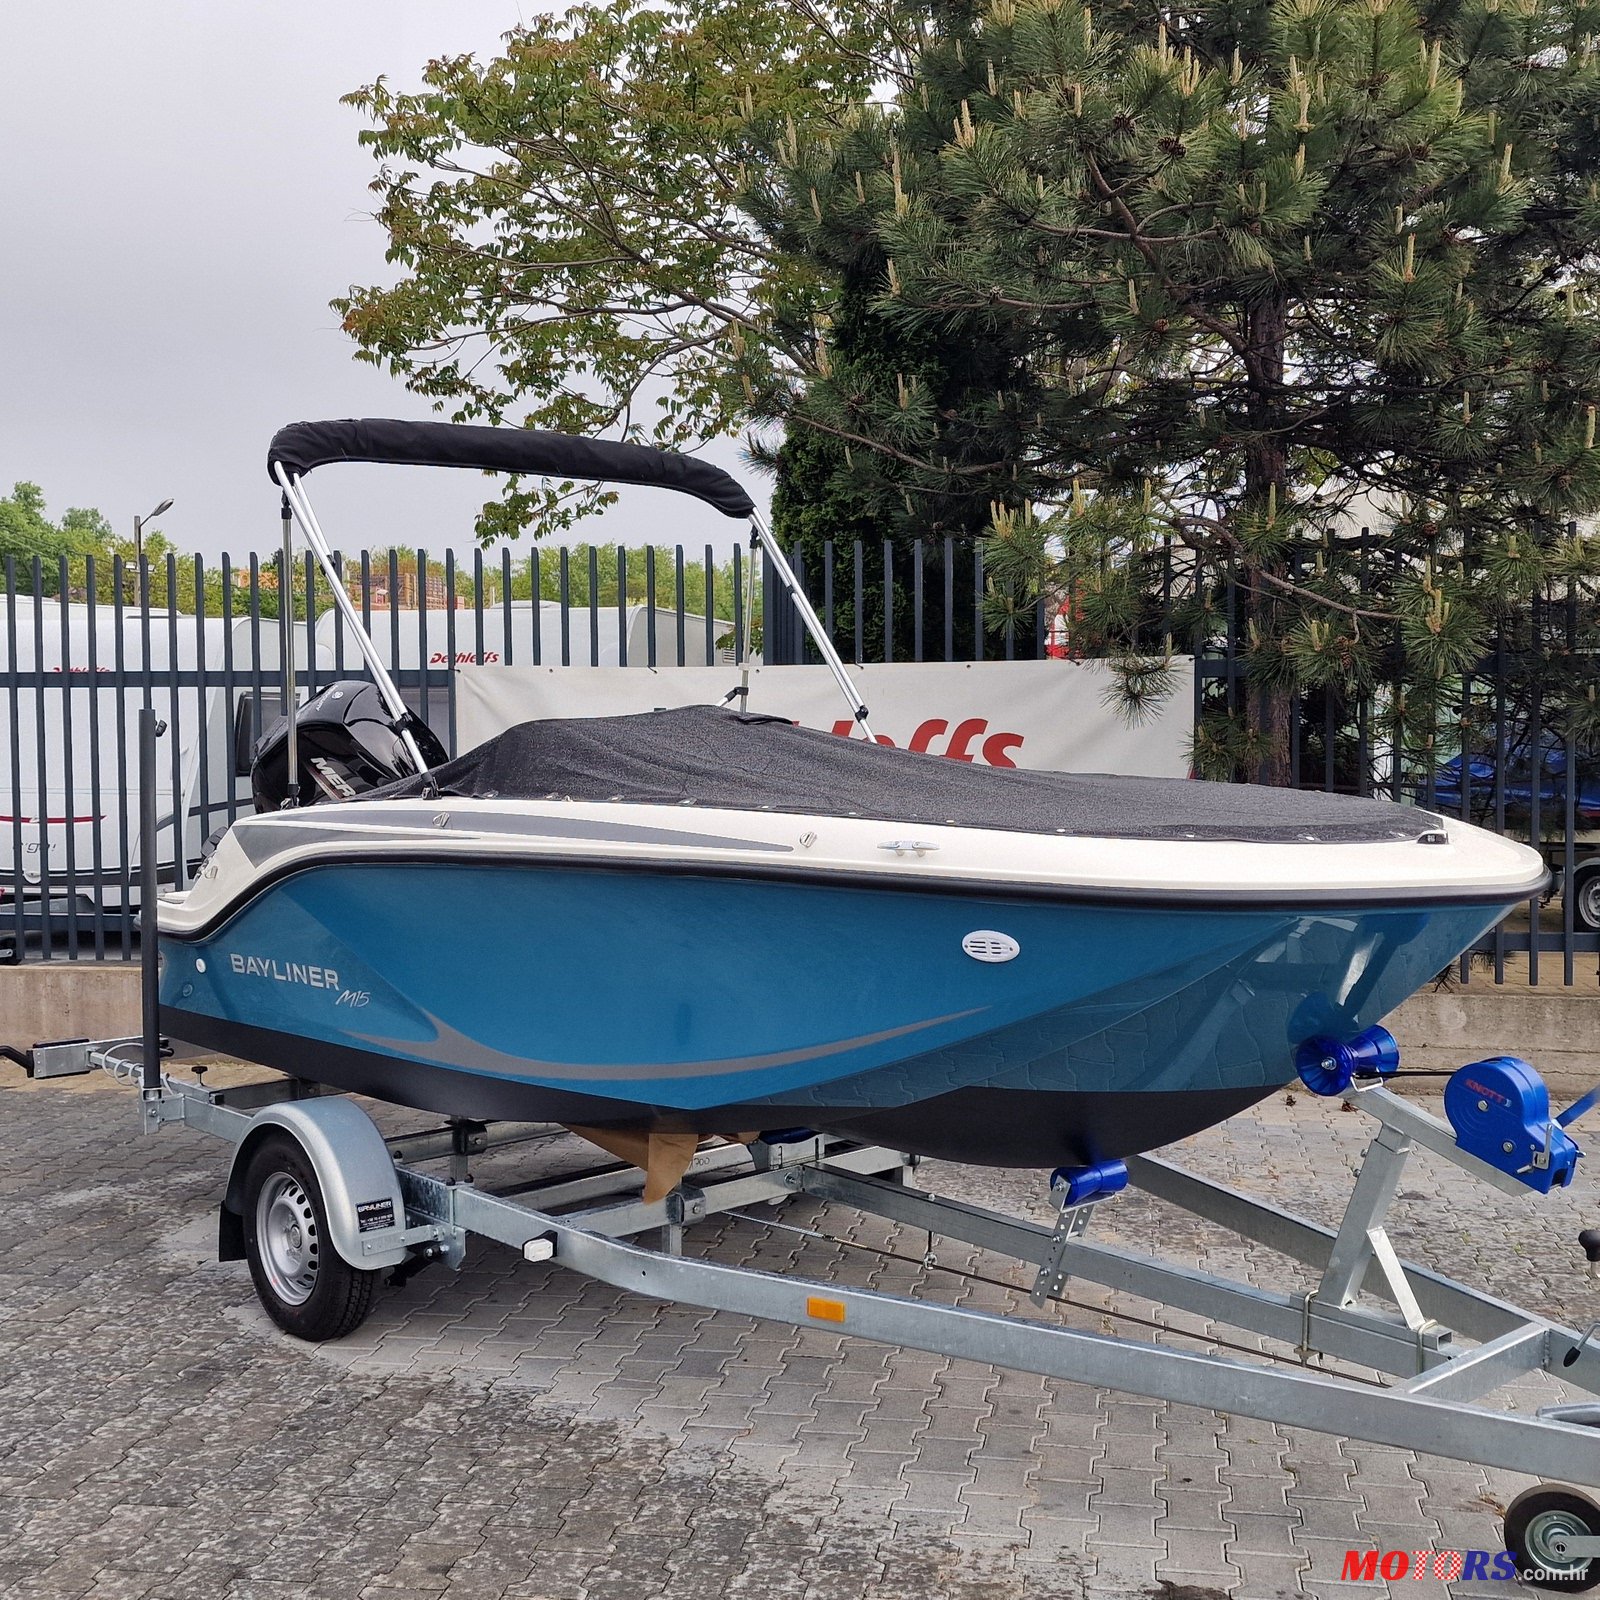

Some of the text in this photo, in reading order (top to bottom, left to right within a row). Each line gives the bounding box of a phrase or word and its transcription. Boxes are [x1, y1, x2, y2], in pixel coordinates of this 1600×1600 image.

[430, 652, 500, 664] Dehlefs
[229, 952, 340, 992] BAYLINER
[335, 988, 371, 1008] M15
